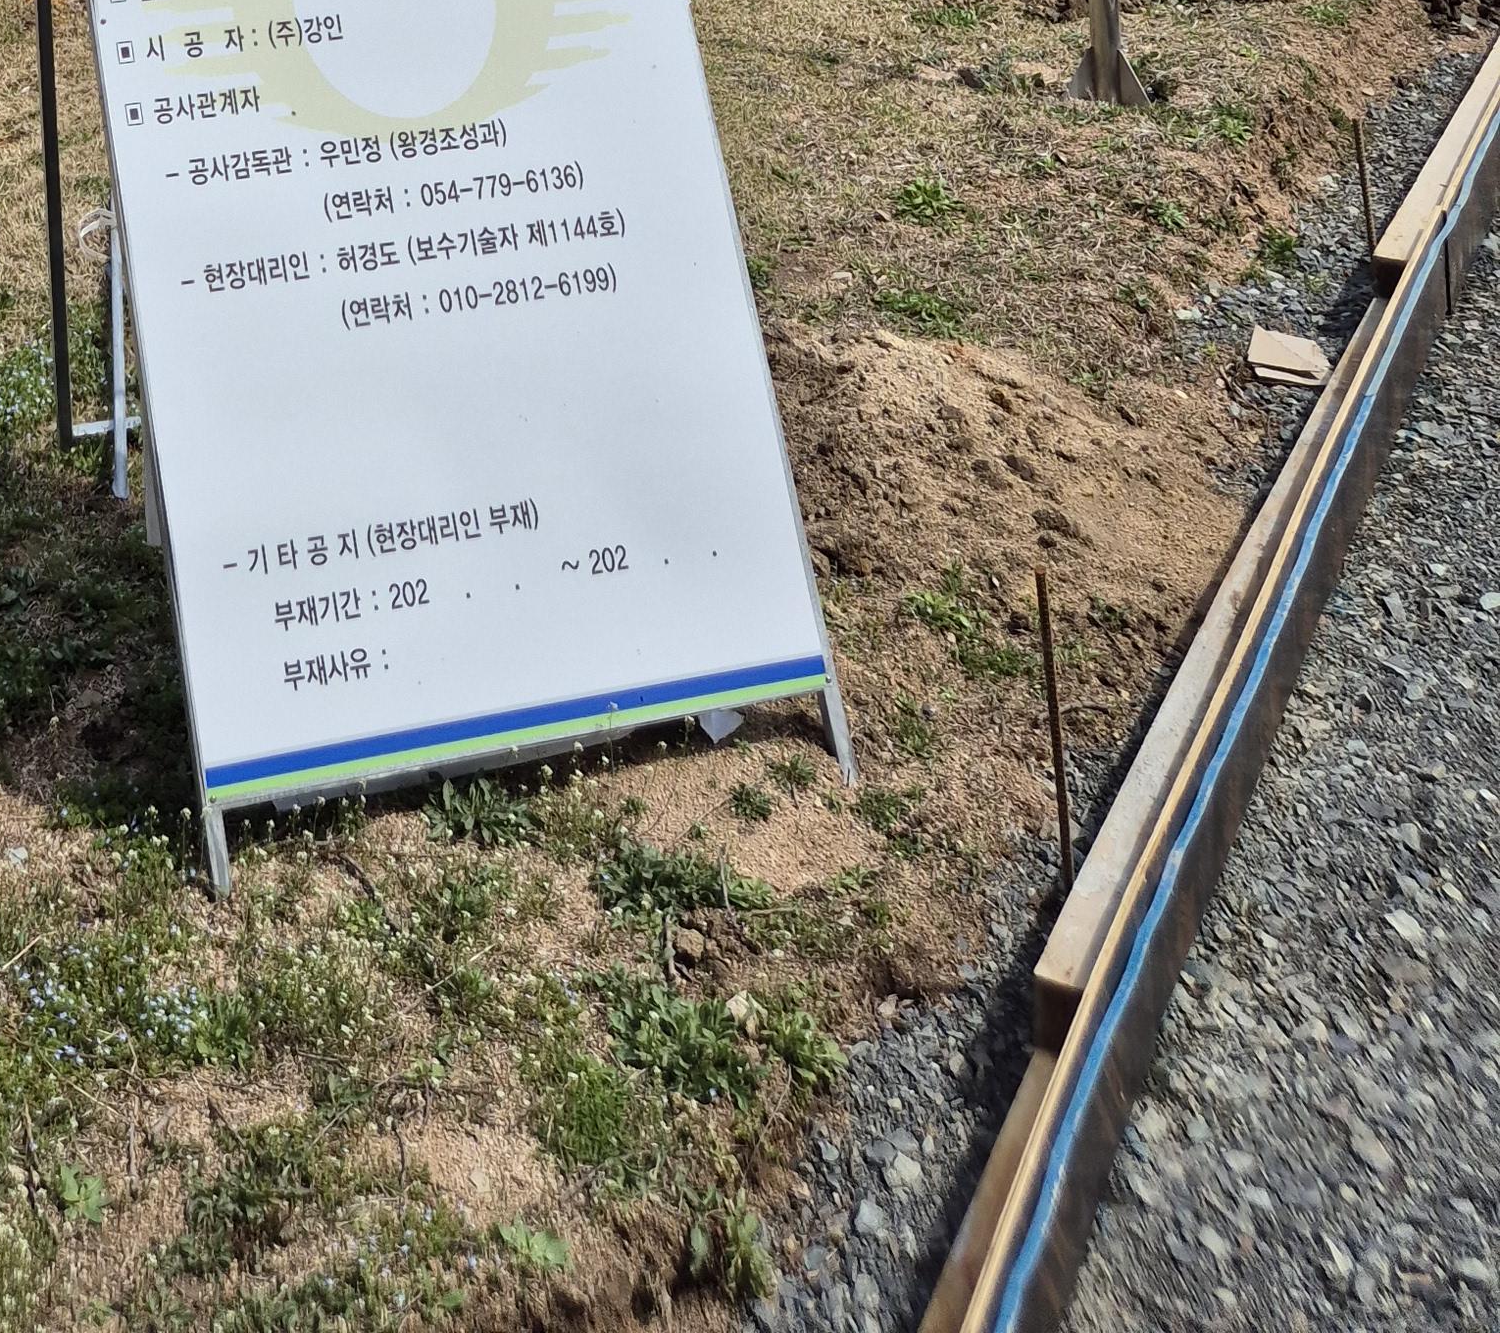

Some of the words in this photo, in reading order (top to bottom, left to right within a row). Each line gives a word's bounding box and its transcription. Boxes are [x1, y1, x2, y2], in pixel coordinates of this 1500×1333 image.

[267, 12, 345, 51] (주)강인
[152, 84, 262, 126] 공사관계자
[187, 144, 294, 187] 공사감독관
[318, 133, 383, 170] 우민정
[388, 116, 508, 162] (왕경조성과)
[322, 184, 396, 225] (연락처
[419, 159, 585, 208] 054-779-6136)
[202, 249, 312, 294] 현장대리인
[335, 240, 402, 275] 허경도
[406, 221, 520, 267] (보수기술자
[524, 206, 627, 249] 제1144호)
[340, 290, 414, 332] (연락처
[437, 261, 618, 315] 010-2812-6199)
[365, 507, 483, 559] (현장대리인
[488, 496, 540, 536] 부재)
[273, 586, 363, 633] 부재기간
[387, 577, 431, 611] 202
[587, 543, 631, 577] 202
[282, 646, 373, 693] 부재사유
